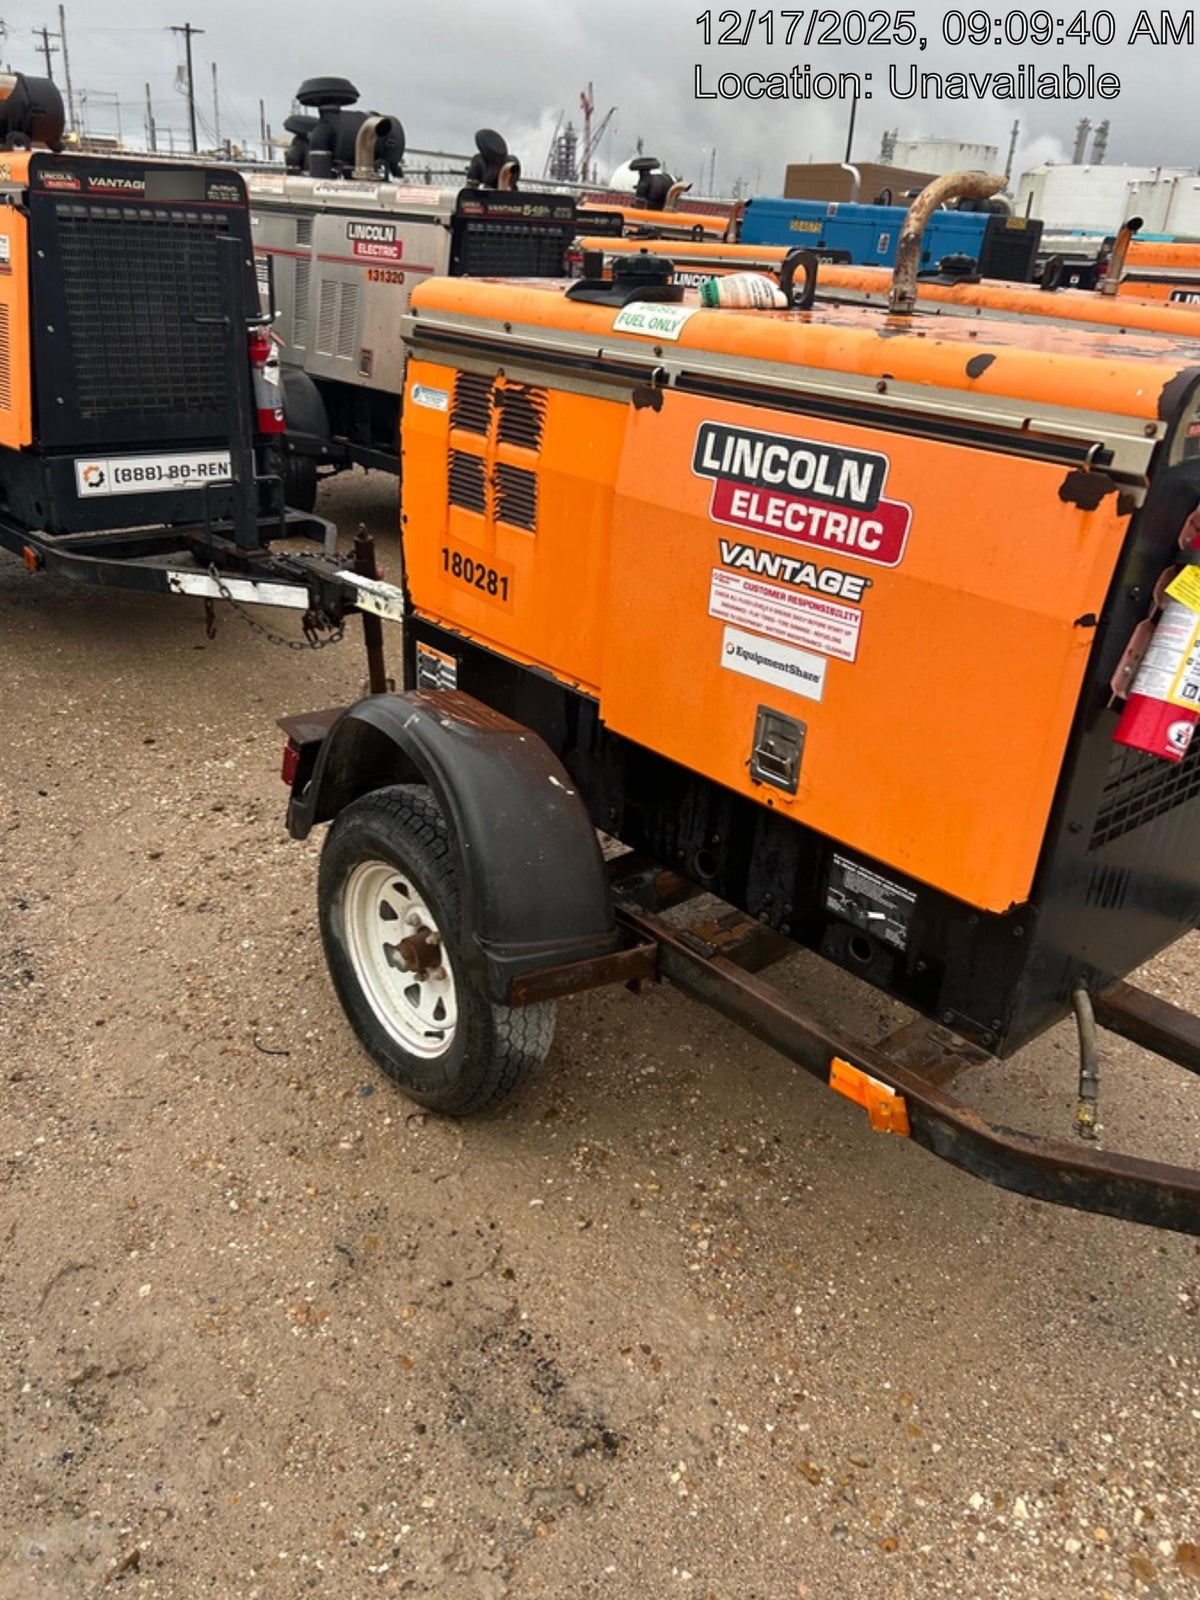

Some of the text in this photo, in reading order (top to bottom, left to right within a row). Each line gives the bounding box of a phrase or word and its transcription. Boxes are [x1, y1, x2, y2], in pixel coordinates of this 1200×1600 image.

[349, 223, 394, 243] LINCOLN
[357, 243, 398, 258] ELECTRIC
[367, 269, 405, 285] 131320
[618, 312, 680, 332] FUEL ONLY
[114, 462, 232, 484] (888) 80-REN
[702, 431, 874, 503] LINCOLN
[730, 489, 884, 550] ELECTRIC
[442, 547, 509, 601] 180281
[720, 540, 866, 602] VANTAGE
[743, 581, 860, 622] CUSTOMER RESPONSIBILITY
[735, 645, 820, 683] EquipmentShare
